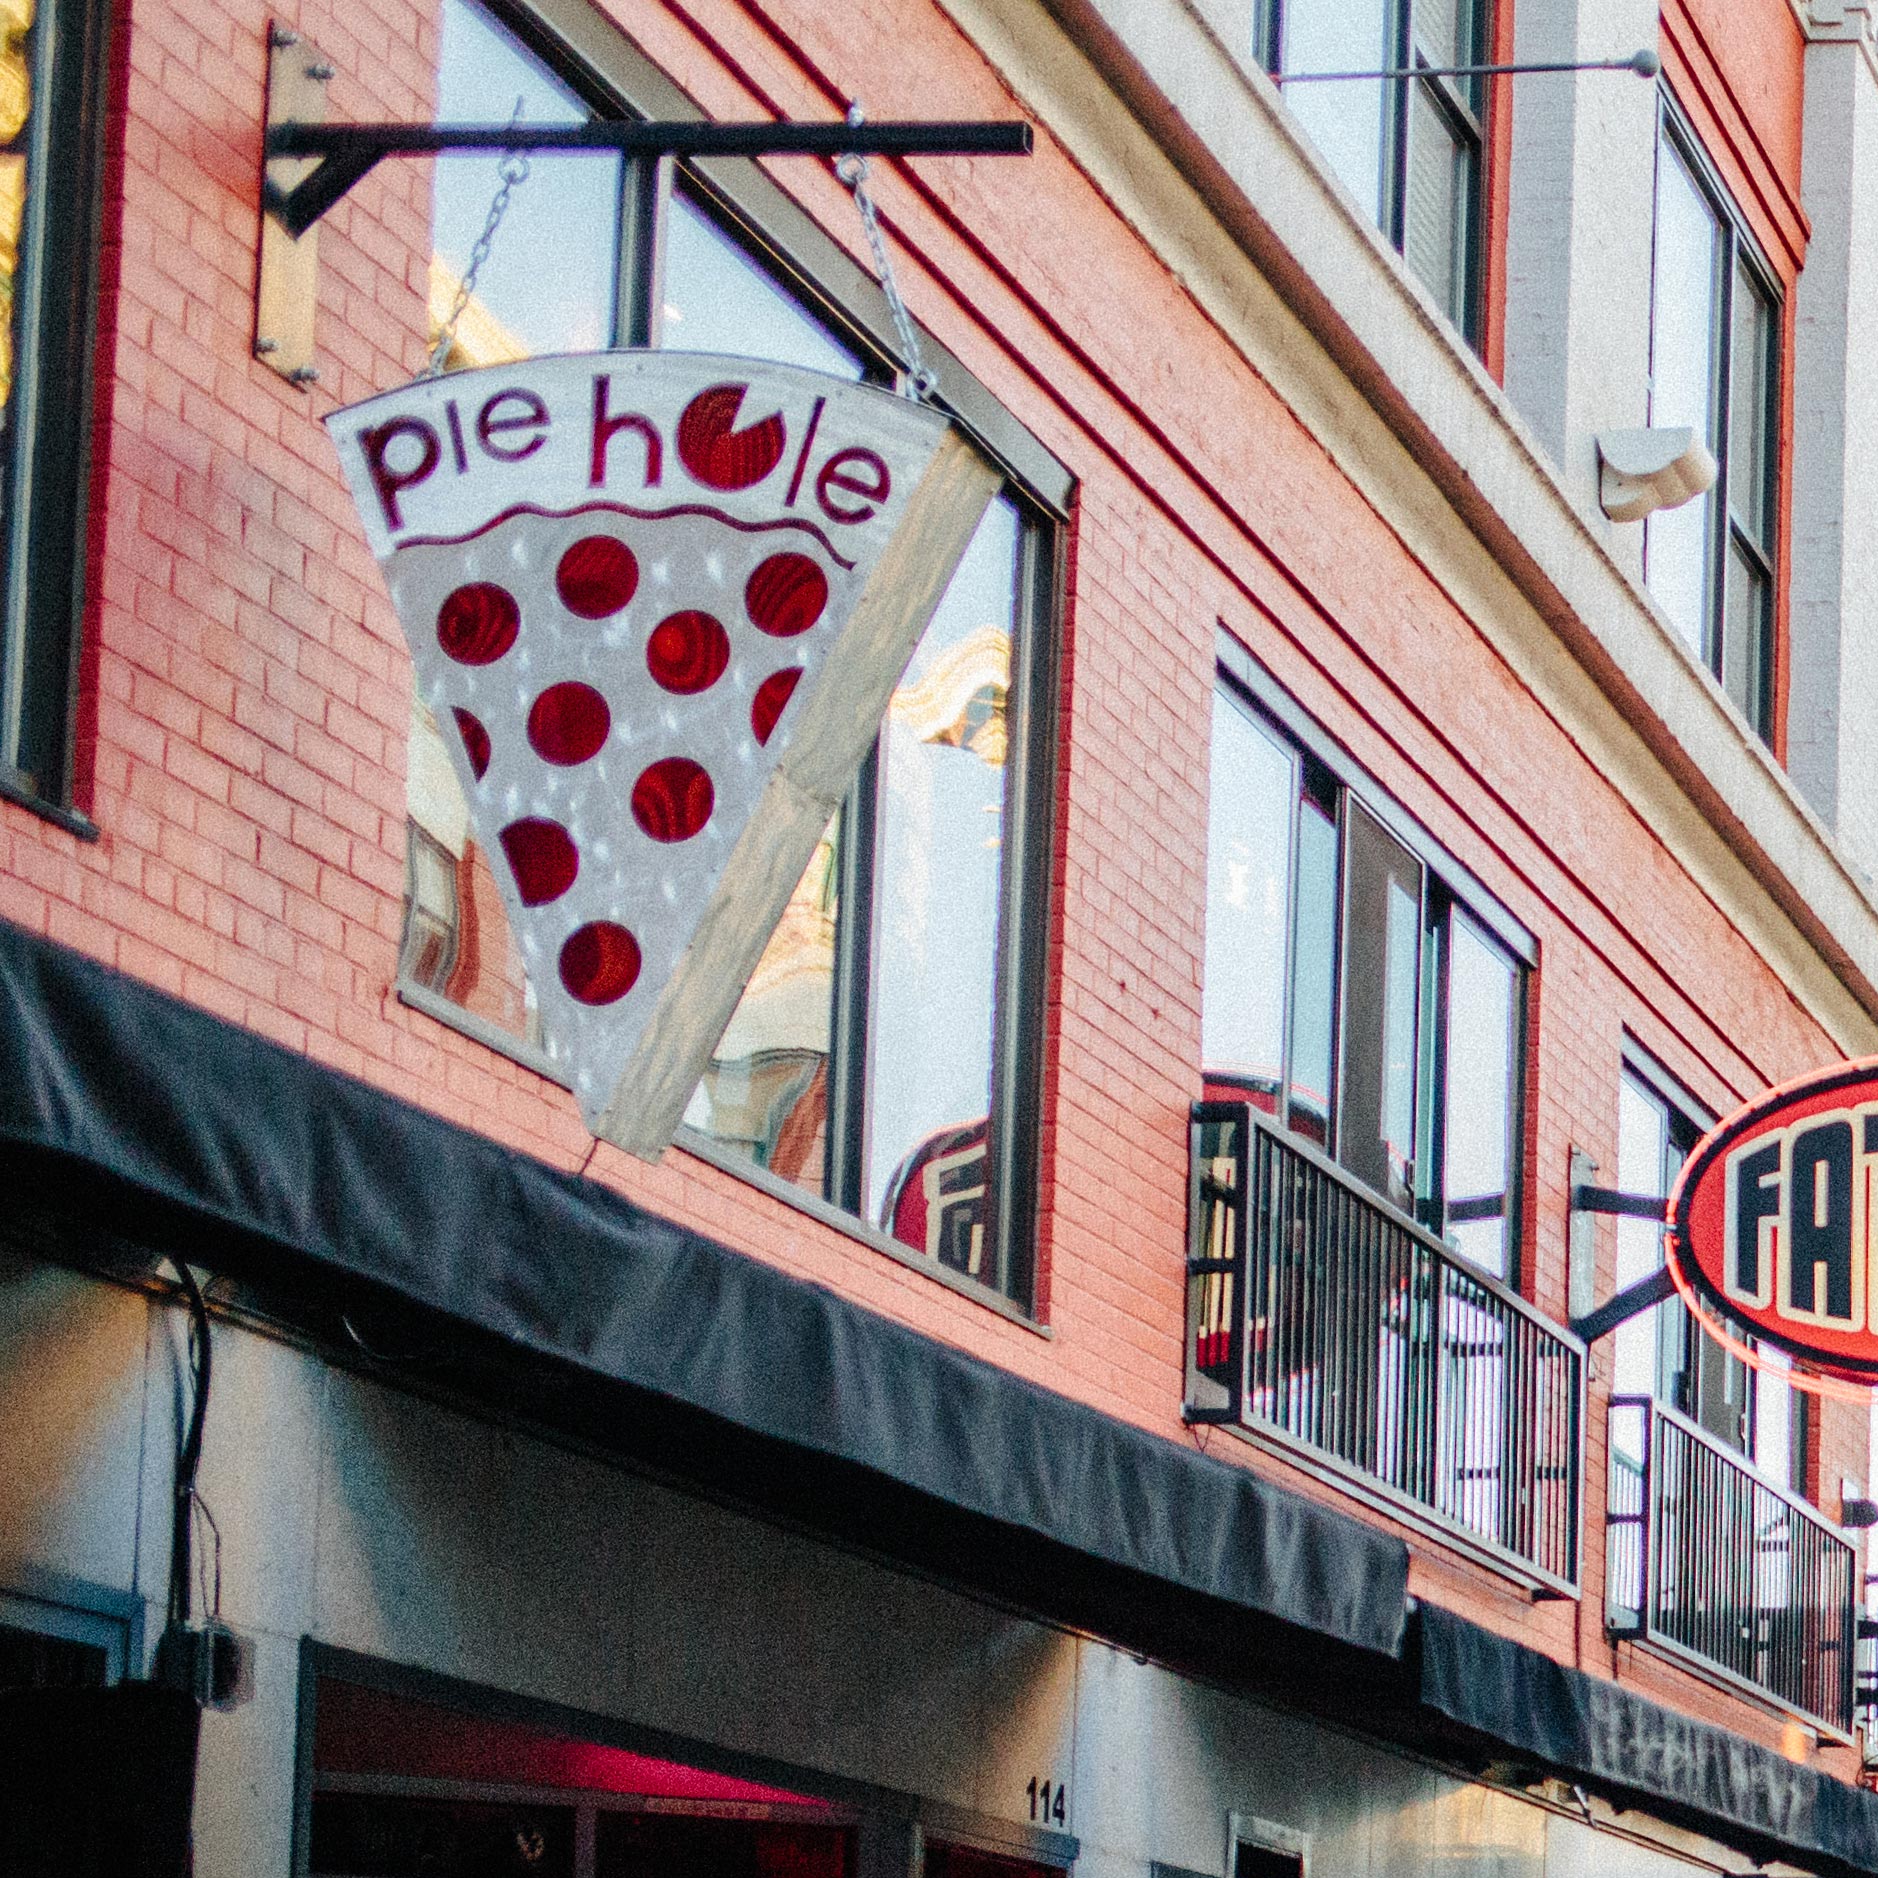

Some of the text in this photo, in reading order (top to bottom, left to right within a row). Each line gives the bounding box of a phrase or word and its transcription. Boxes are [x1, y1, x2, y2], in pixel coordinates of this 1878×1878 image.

[356, 373, 893, 532] pie hole
[1026, 1776, 1066, 1826] 114
